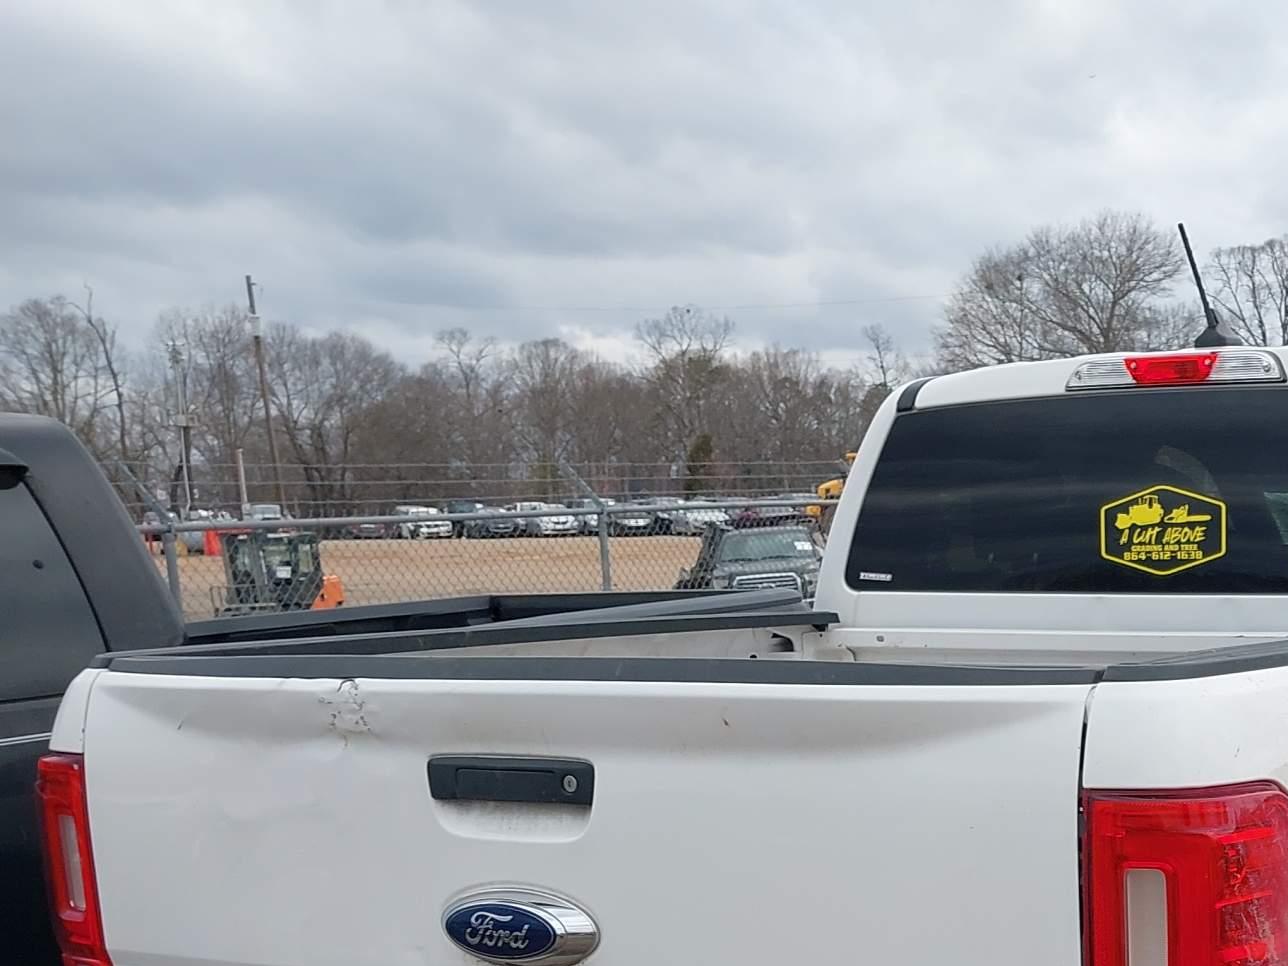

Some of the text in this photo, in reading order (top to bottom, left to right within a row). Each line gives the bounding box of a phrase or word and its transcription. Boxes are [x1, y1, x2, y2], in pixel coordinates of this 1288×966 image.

[1120, 526, 1207, 545] A CUT ABOVE
[464, 911, 530, 949] Ford
